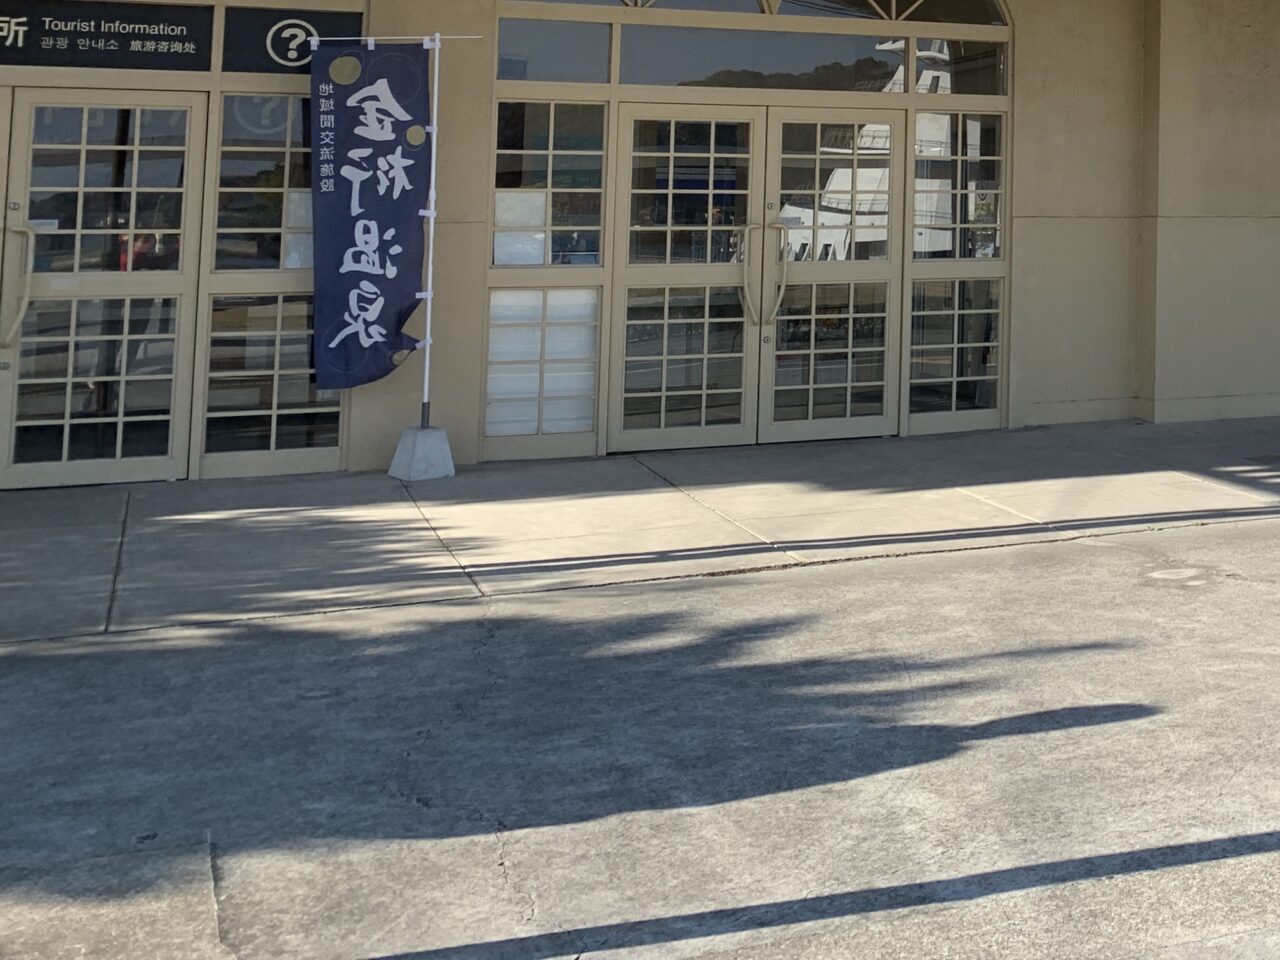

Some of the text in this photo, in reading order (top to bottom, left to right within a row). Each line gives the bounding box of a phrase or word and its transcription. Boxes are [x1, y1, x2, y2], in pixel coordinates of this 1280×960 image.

[42, 17, 187, 36] Tourist Information
[41, 37, 119, 51] 관광 안내소
[130, 40, 196, 54] 旅游咨询处
